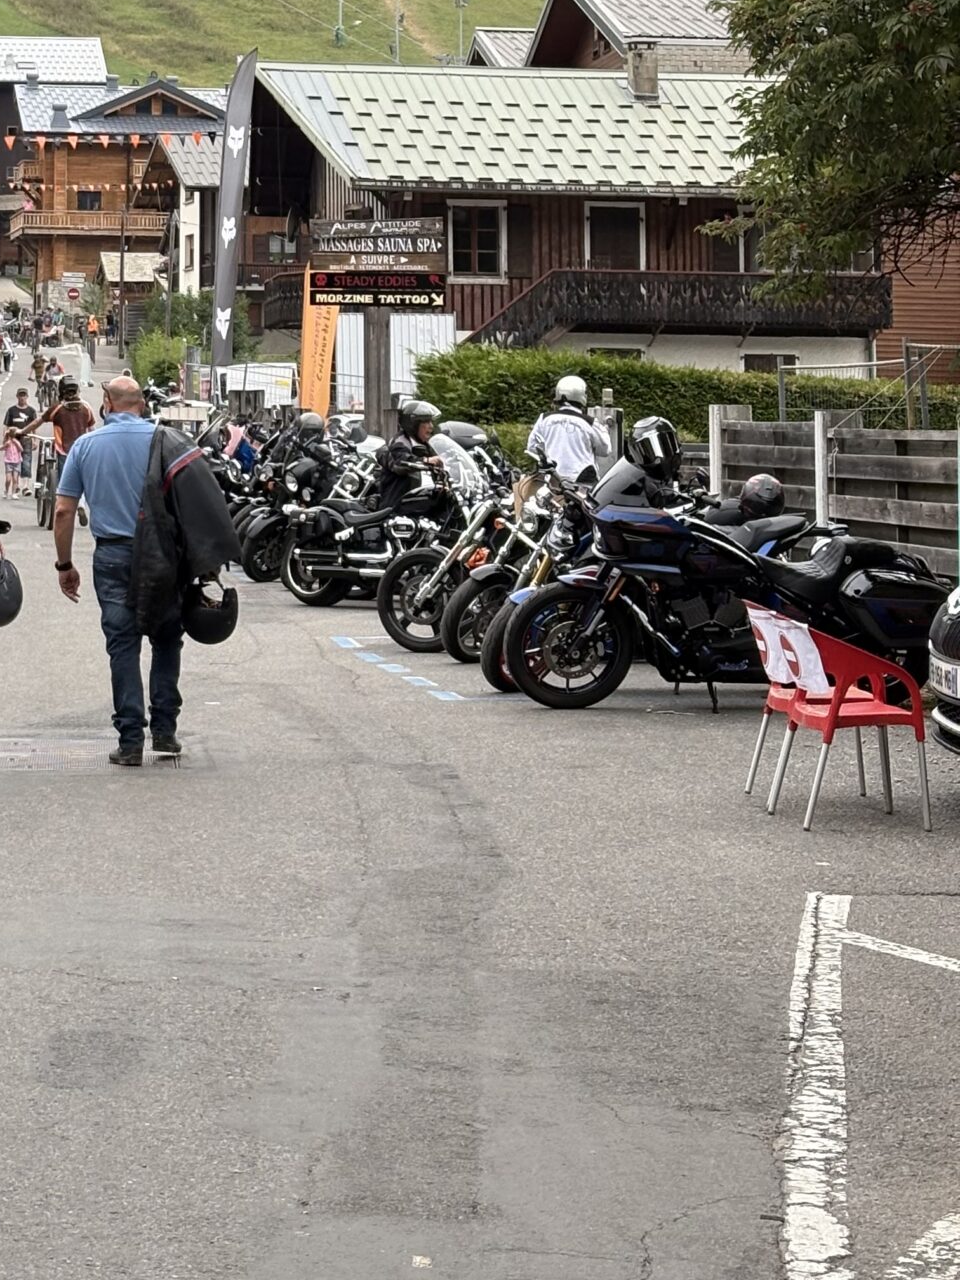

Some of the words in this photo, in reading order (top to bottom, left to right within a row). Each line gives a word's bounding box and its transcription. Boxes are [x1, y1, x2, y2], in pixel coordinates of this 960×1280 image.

[330, 222, 366, 234] ALPES
[370, 220, 421, 233] ATTITUDE
[320, 238, 374, 252] MASSAGES
[377, 238, 413, 252] SAUNA
[417, 238, 438, 252] SPA
[361, 255, 395, 265] SUIVRE
[334, 276, 375, 286] STEADY
[377, 276, 417, 286] EDDIES
[315, 294, 373, 303] MORZINE
[378, 295, 429, 304] TATTOO
